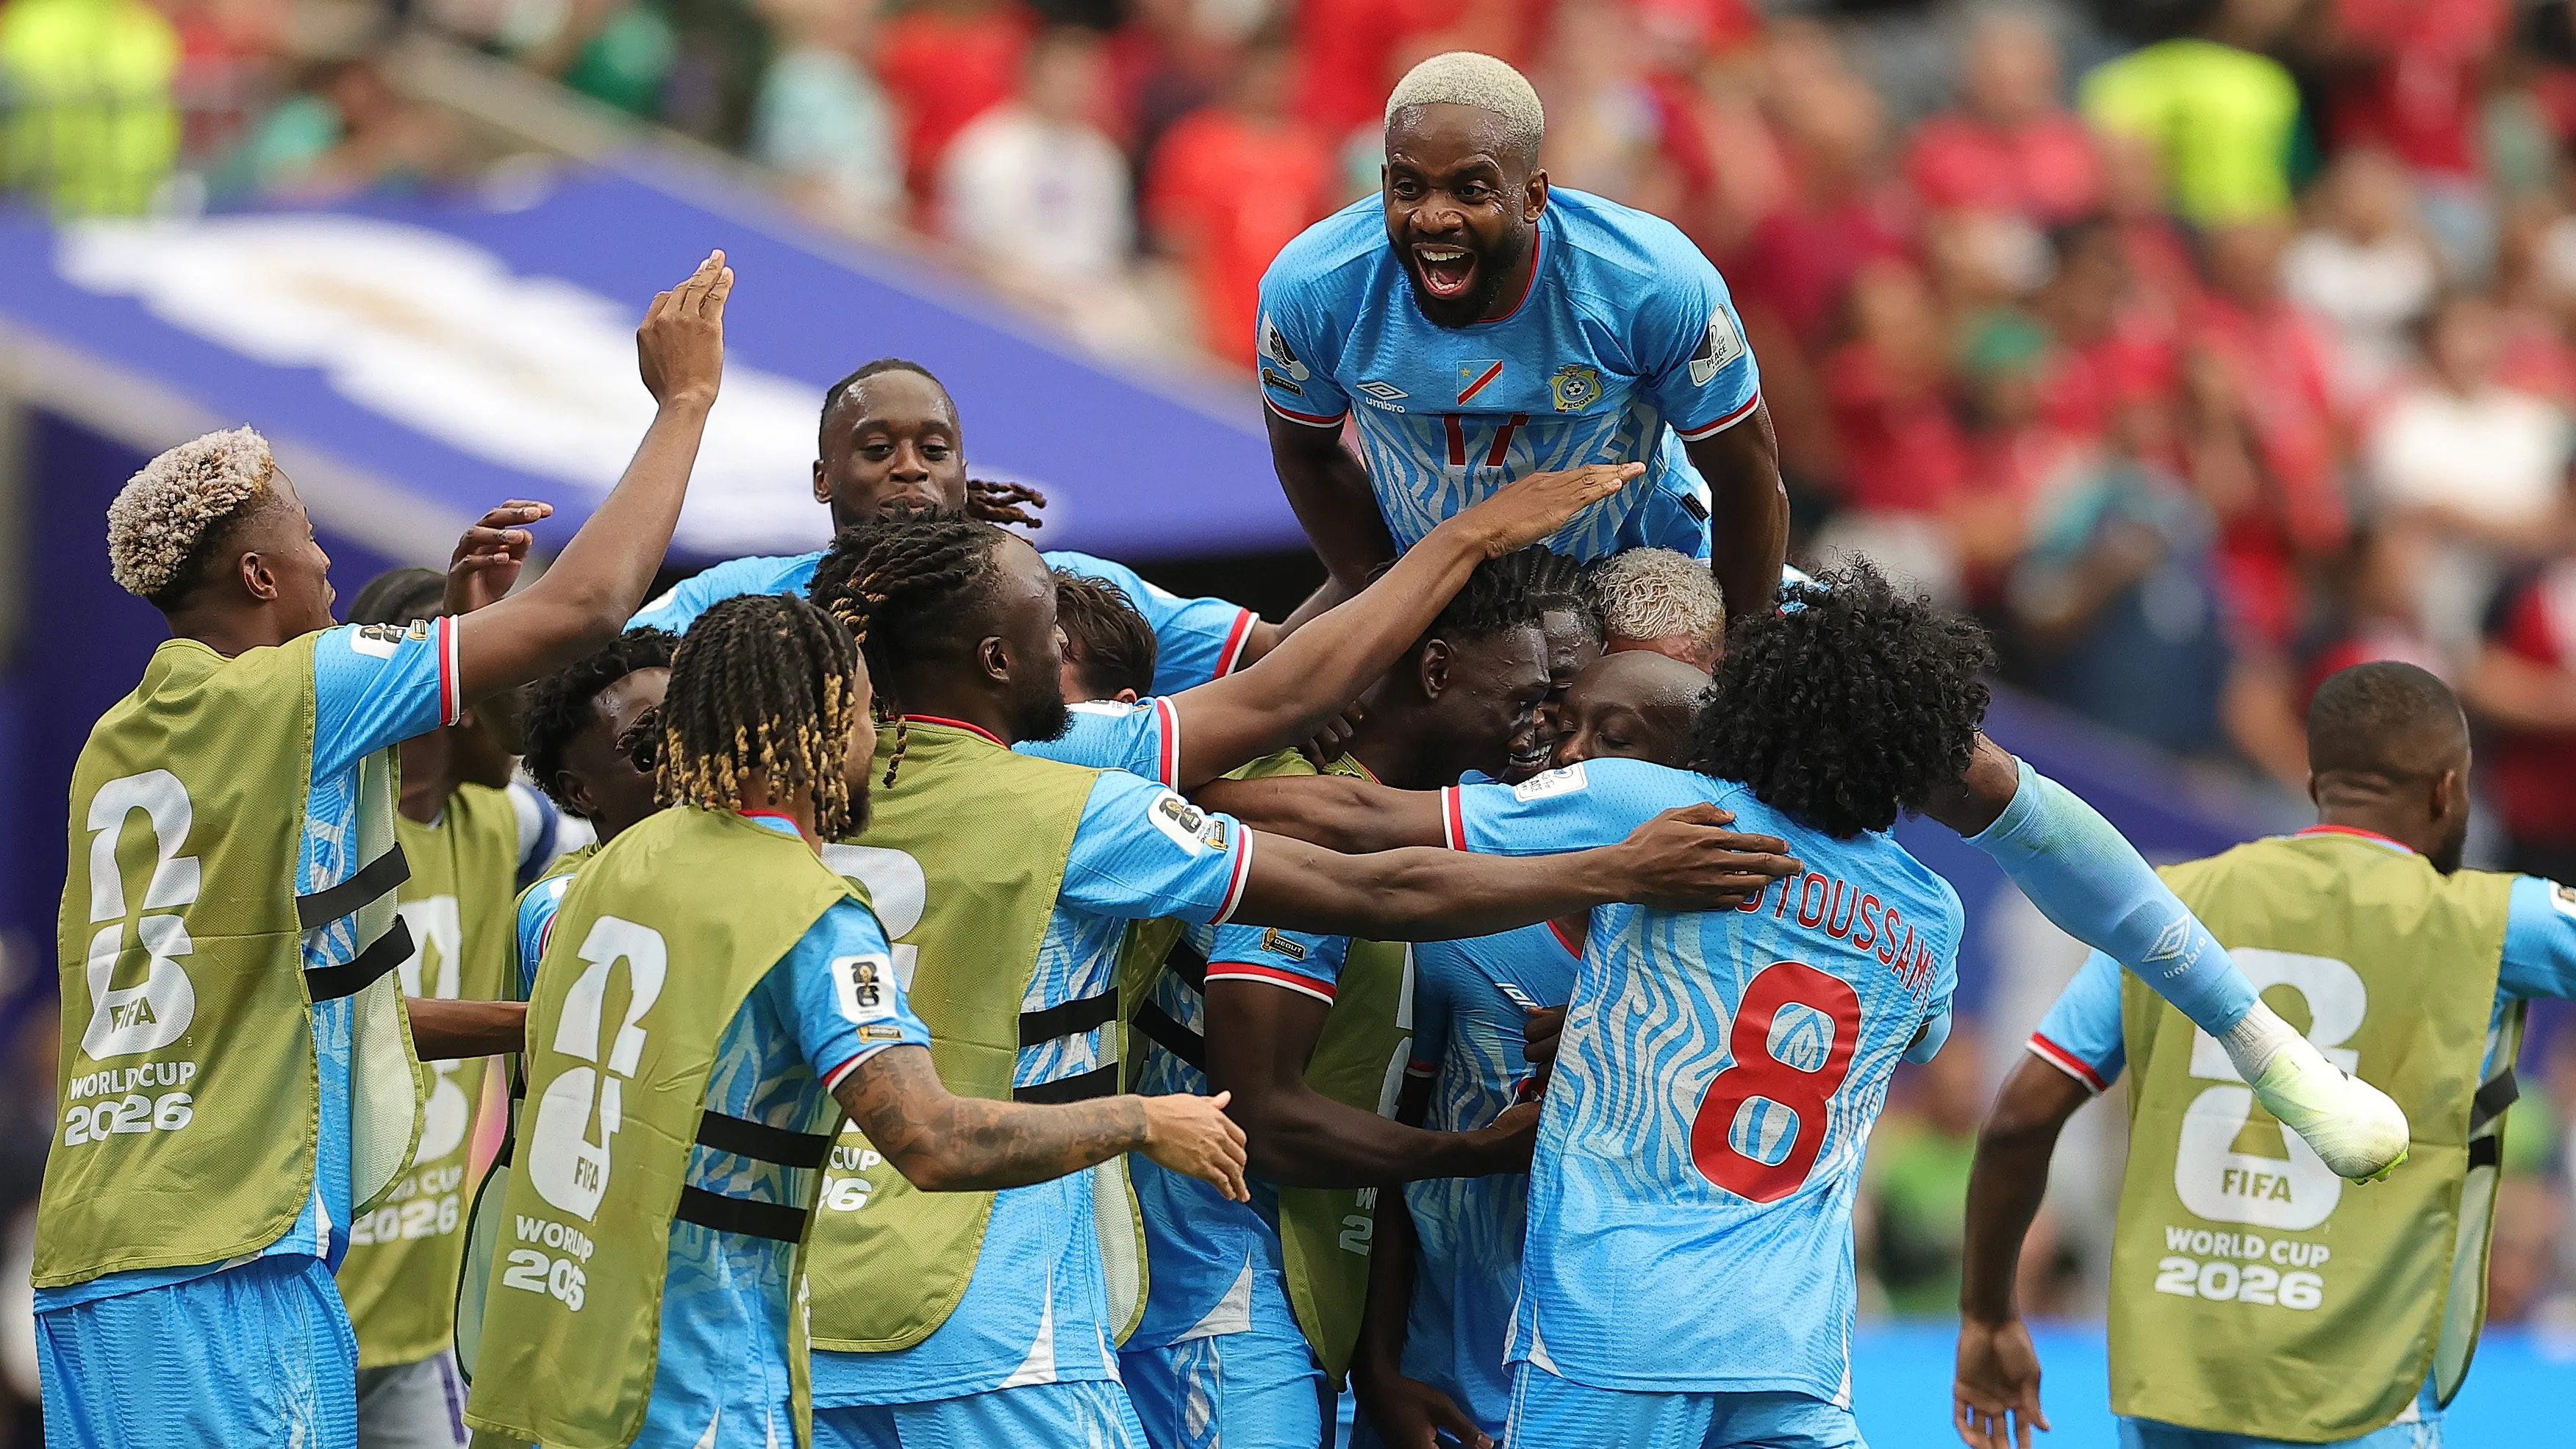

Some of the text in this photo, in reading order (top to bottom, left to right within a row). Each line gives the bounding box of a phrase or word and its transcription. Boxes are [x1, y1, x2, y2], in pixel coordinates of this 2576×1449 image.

[1706, 343, 1728, 368] PEACE
[1365, 397, 1406, 414] umbro
[1442, 415, 1531, 468] 17
[1274, 939, 1303, 953] DEBUT
[2163, 935, 2206, 979] umbro
[110, 996, 157, 1034] FIFA
[70, 1062, 197, 1101] WORLD CUP
[1689, 960, 1862, 1204] 8
[65, 1092, 194, 1147] 2026
[573, 1156, 601, 1194] FIFA
[829, 1145, 883, 1172] CUP
[2222, 1168, 2292, 1203] FIFA
[349, 1192, 462, 1246] 2026
[2164, 1225, 2332, 1269] WORLD CUP
[2154, 1255, 2325, 1311] 2026
